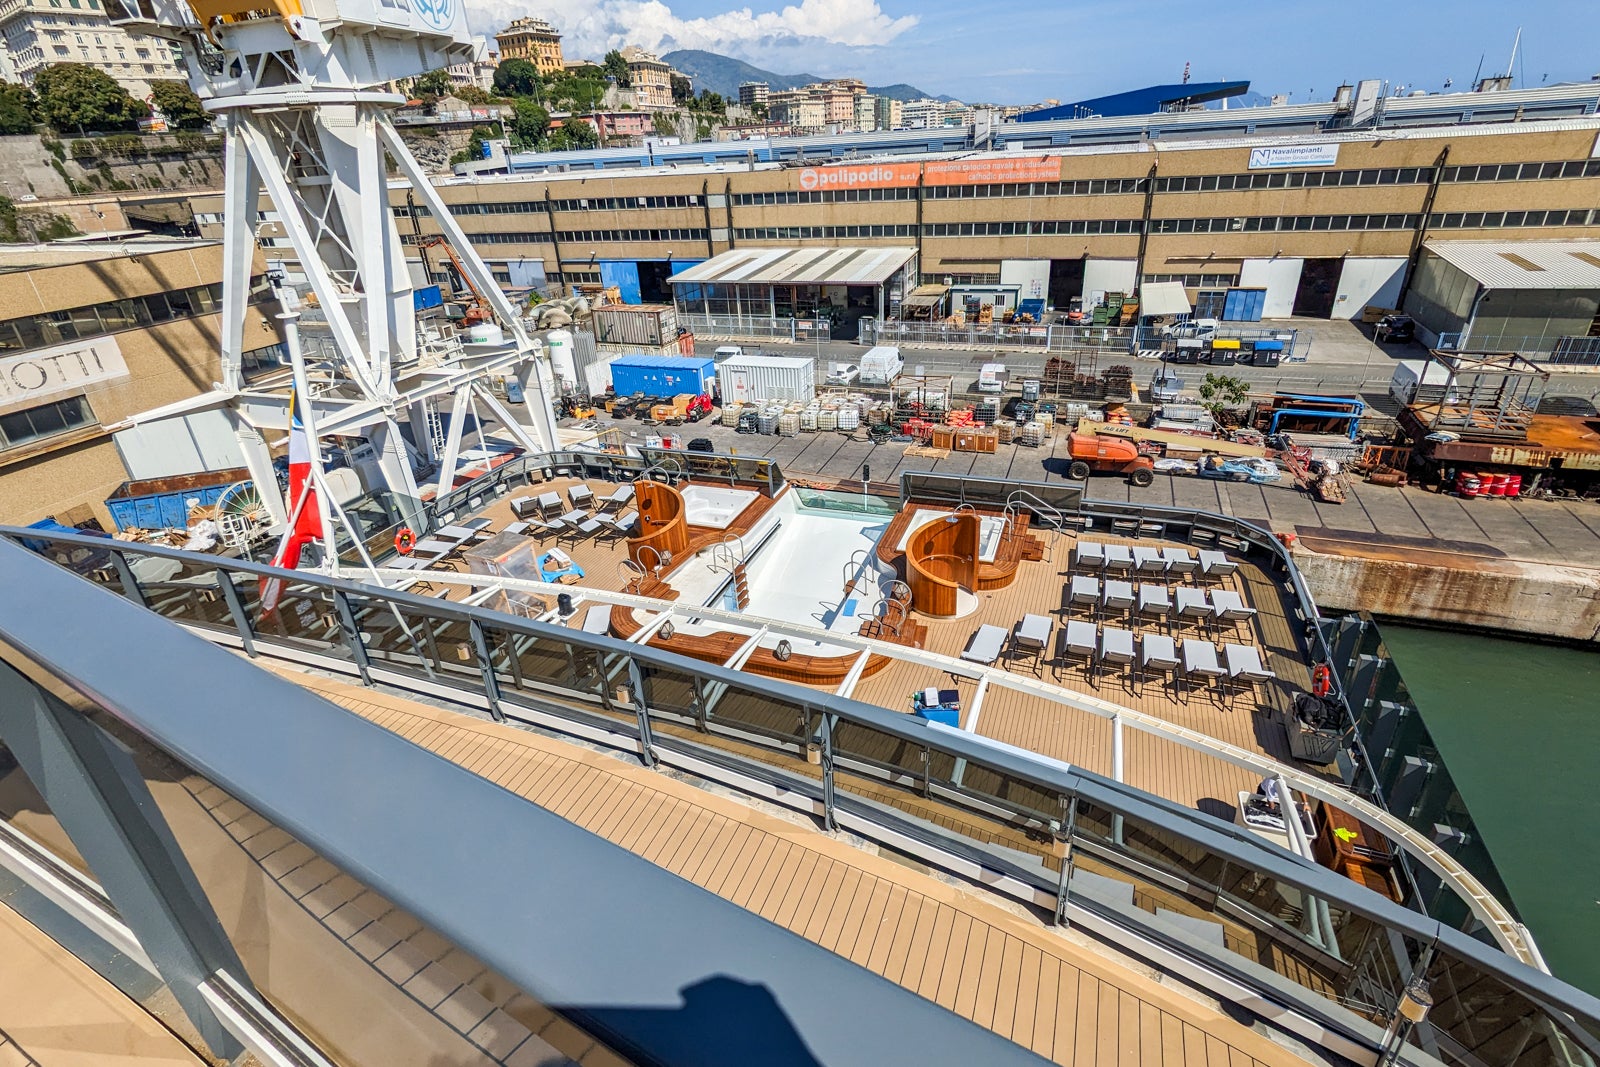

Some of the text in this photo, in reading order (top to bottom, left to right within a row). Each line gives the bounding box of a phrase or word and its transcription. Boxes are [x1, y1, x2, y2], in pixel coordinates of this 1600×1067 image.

[1272, 147, 1322, 155] Navalimpianti
[927, 164, 961, 173] protezione
[962, 163, 991, 171] catodica
[992, 161, 1014, 170] navale
[819, 167, 918, 186] polipodio s.r.l.
[968, 172, 996, 180] cathodic
[1033, 170, 1059, 179] system
